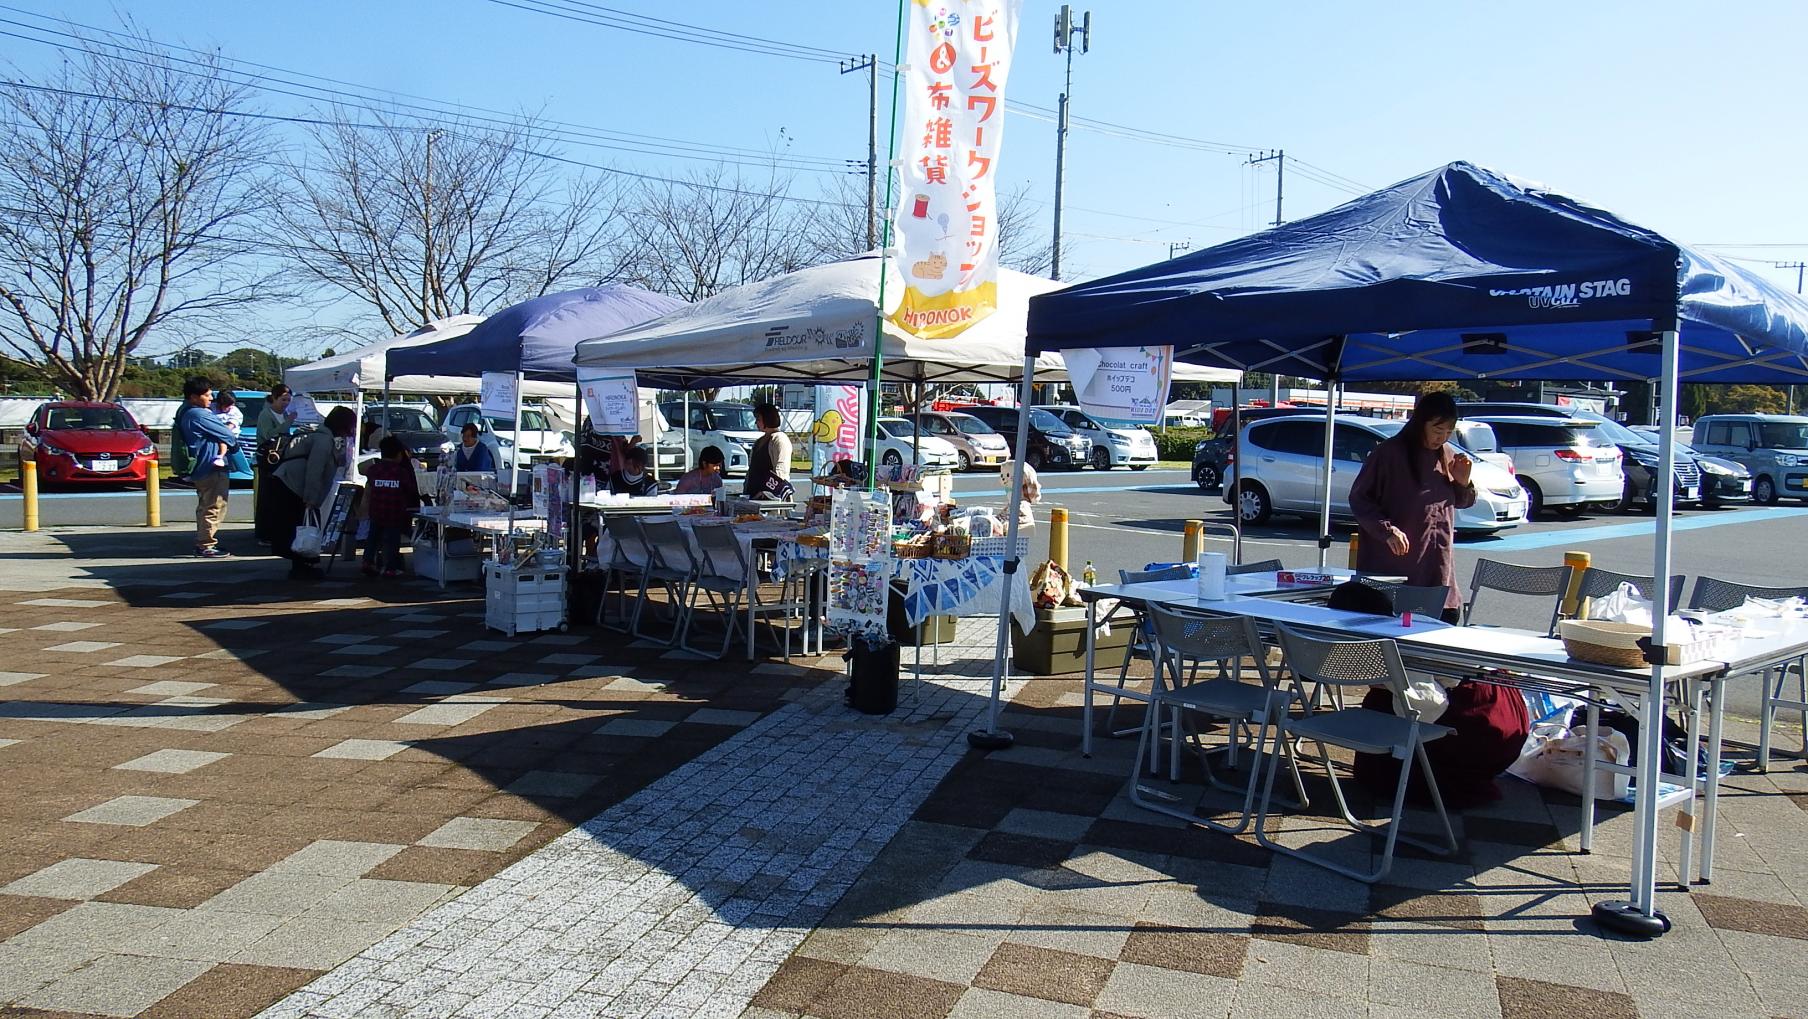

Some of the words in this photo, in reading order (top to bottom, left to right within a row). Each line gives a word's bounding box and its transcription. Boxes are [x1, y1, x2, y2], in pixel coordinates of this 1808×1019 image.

[1579, 278, 1632, 298] STAG
[1130, 361, 1148, 370] craft
[1111, 384, 1131, 393] 500円
[374, 479, 400, 488] EDWIN
[765, 476, 779, 490] 28
